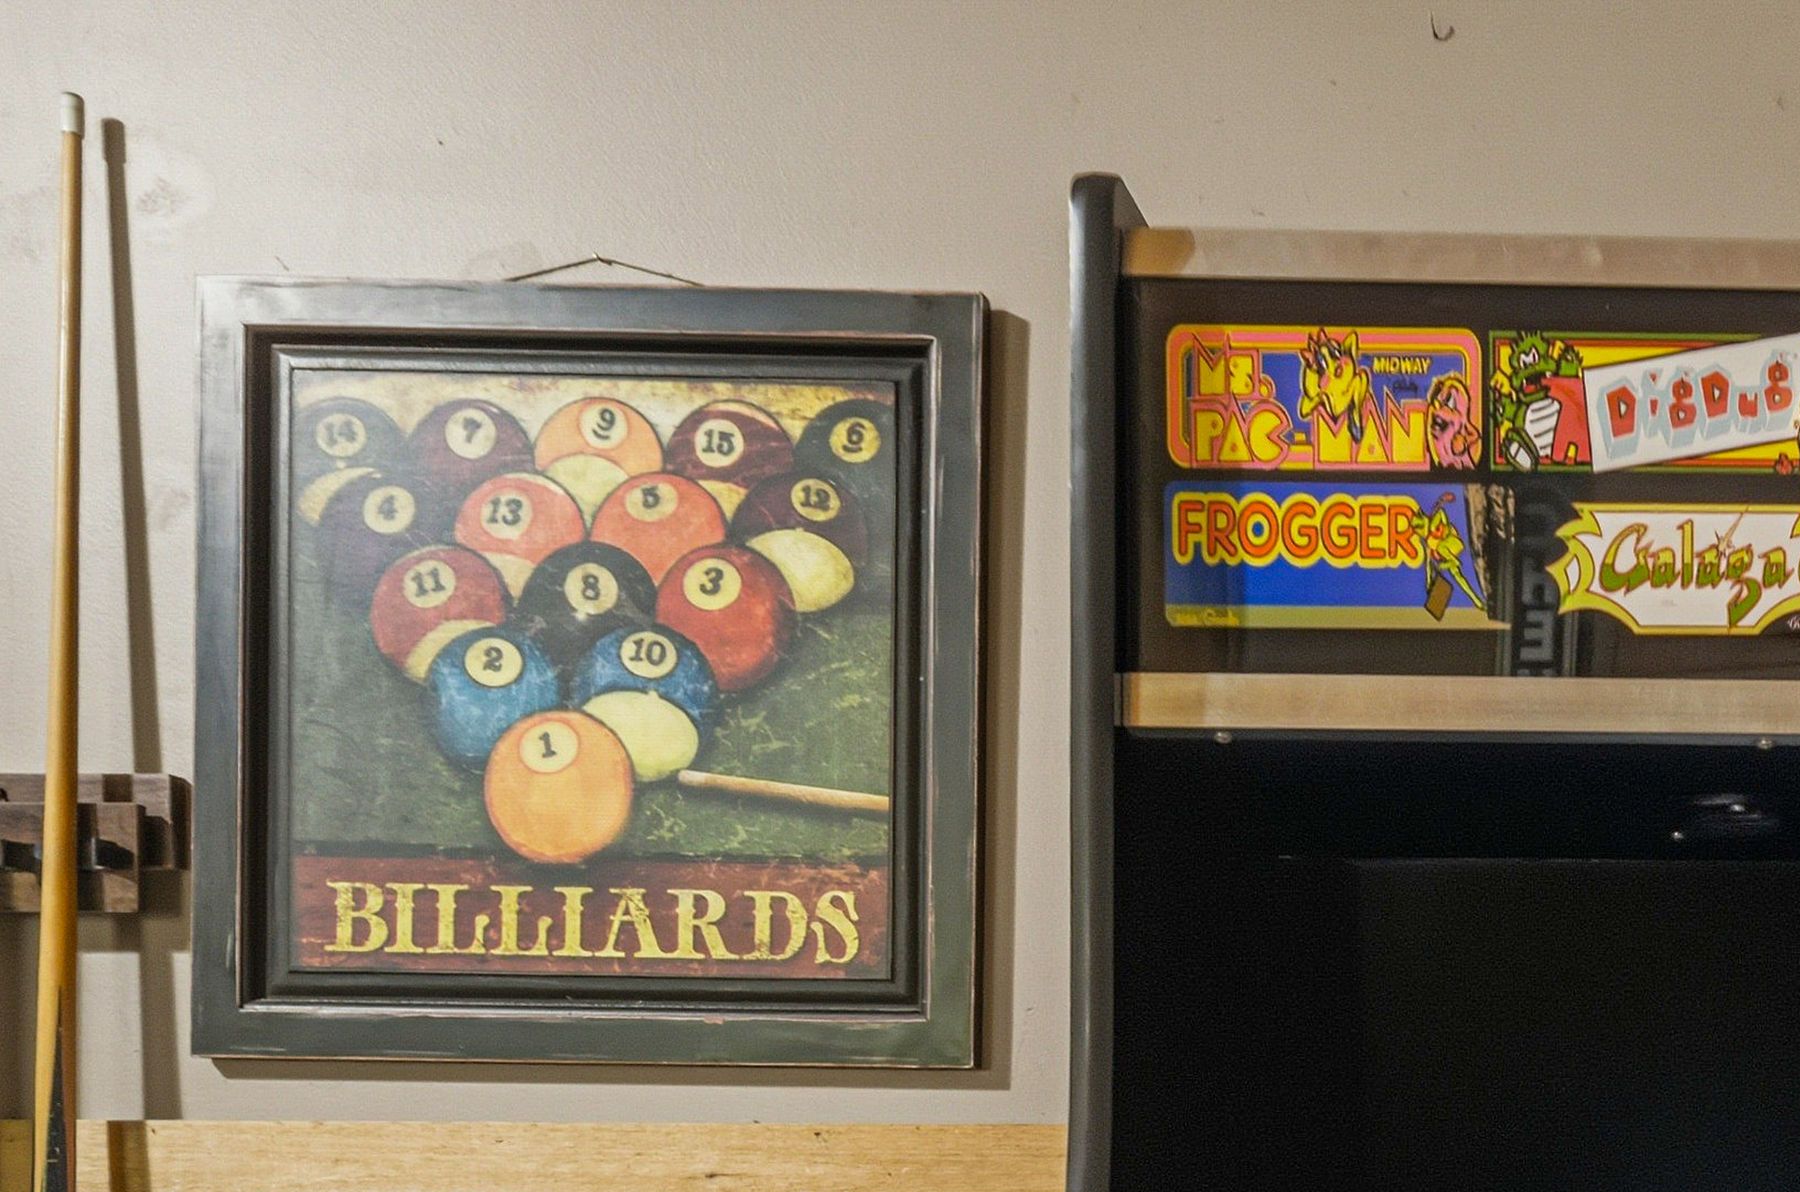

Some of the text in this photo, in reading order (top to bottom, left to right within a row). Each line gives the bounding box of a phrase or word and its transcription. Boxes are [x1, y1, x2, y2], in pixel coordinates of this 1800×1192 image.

[1373, 356, 1431, 375] MIDWAY
[324, 419, 358, 448] 14
[462, 416, 483, 444] 7
[595, 407, 617, 434] 9
[844, 421, 866, 447] 6
[1192, 390, 1429, 467] PAC-MAN
[700, 428, 736, 457] 15
[376, 494, 399, 522] 4
[486, 497, 524, 527] 13
[640, 486, 661, 510] 5
[801, 484, 832, 512] 12
[1176, 498, 1420, 561] FROGGER
[410, 566, 447, 599] 11
[580, 573, 602, 602] 8
[699, 566, 725, 597] 3
[1600, 519, 1794, 628] Galaga
[482, 645, 505, 674] 2
[628, 637, 668, 667] 10
[537, 730, 558, 760] 1
[324, 880, 861, 965] BILLIARDS
